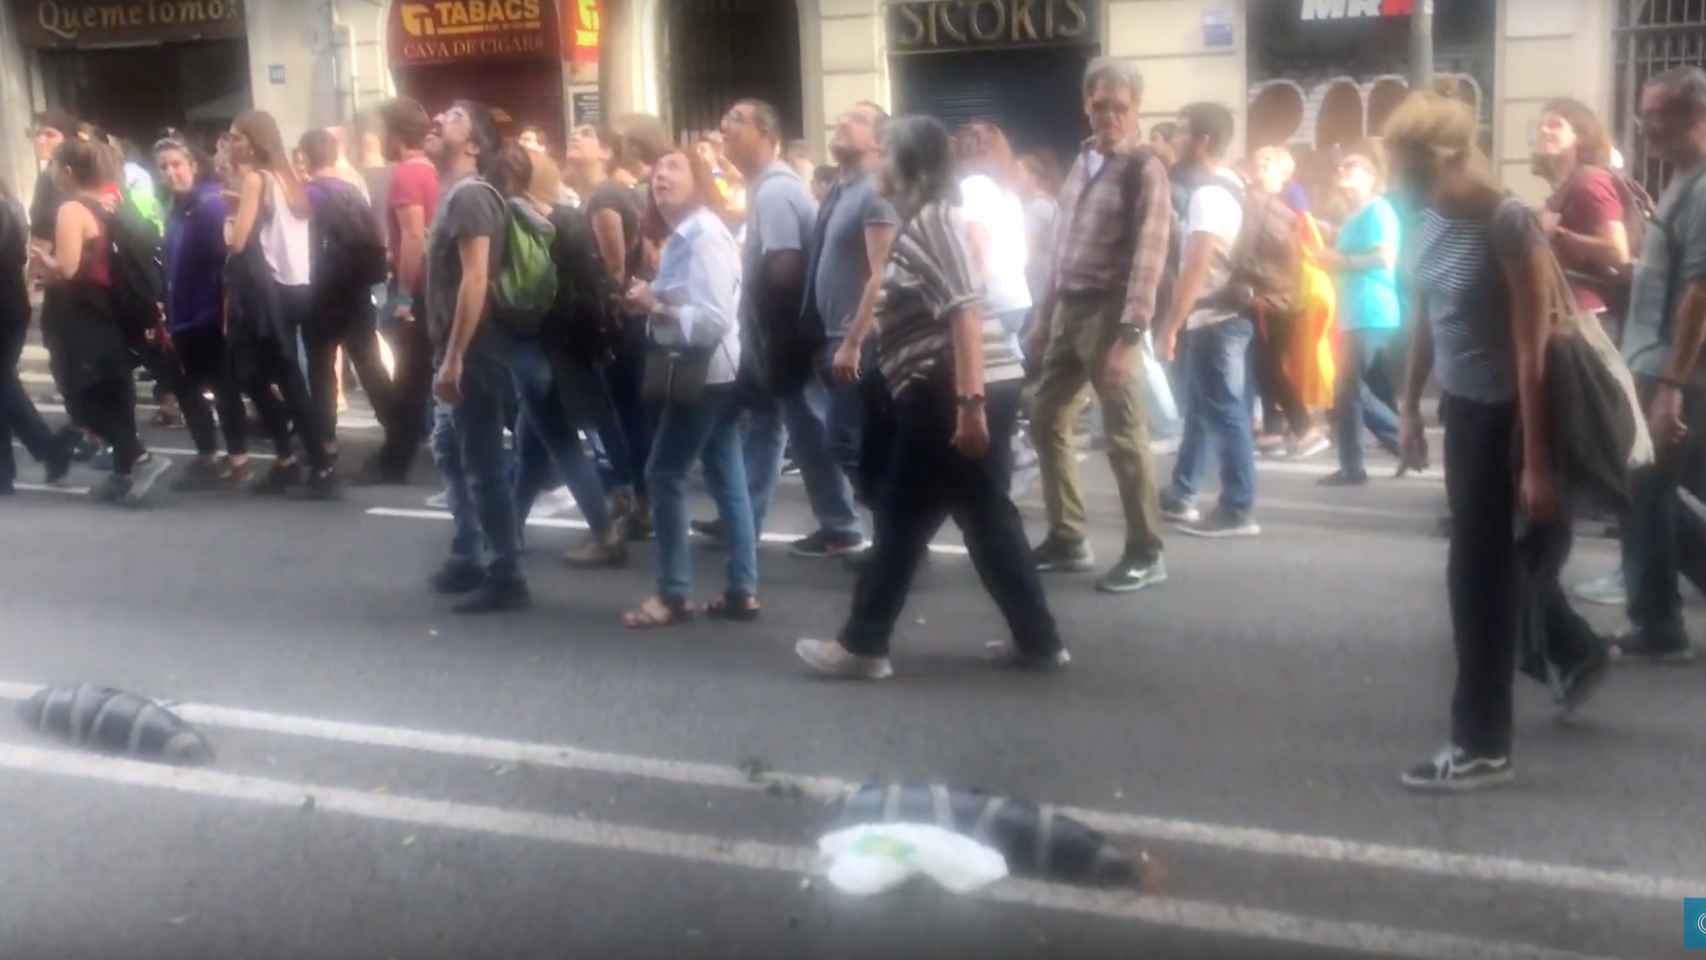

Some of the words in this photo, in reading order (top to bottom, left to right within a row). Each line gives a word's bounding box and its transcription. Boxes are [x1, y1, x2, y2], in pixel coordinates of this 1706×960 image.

[434, 0, 540, 25] TABACS
[403, 39, 450, 58] CAVA
[454, 37, 474, 57] DE
